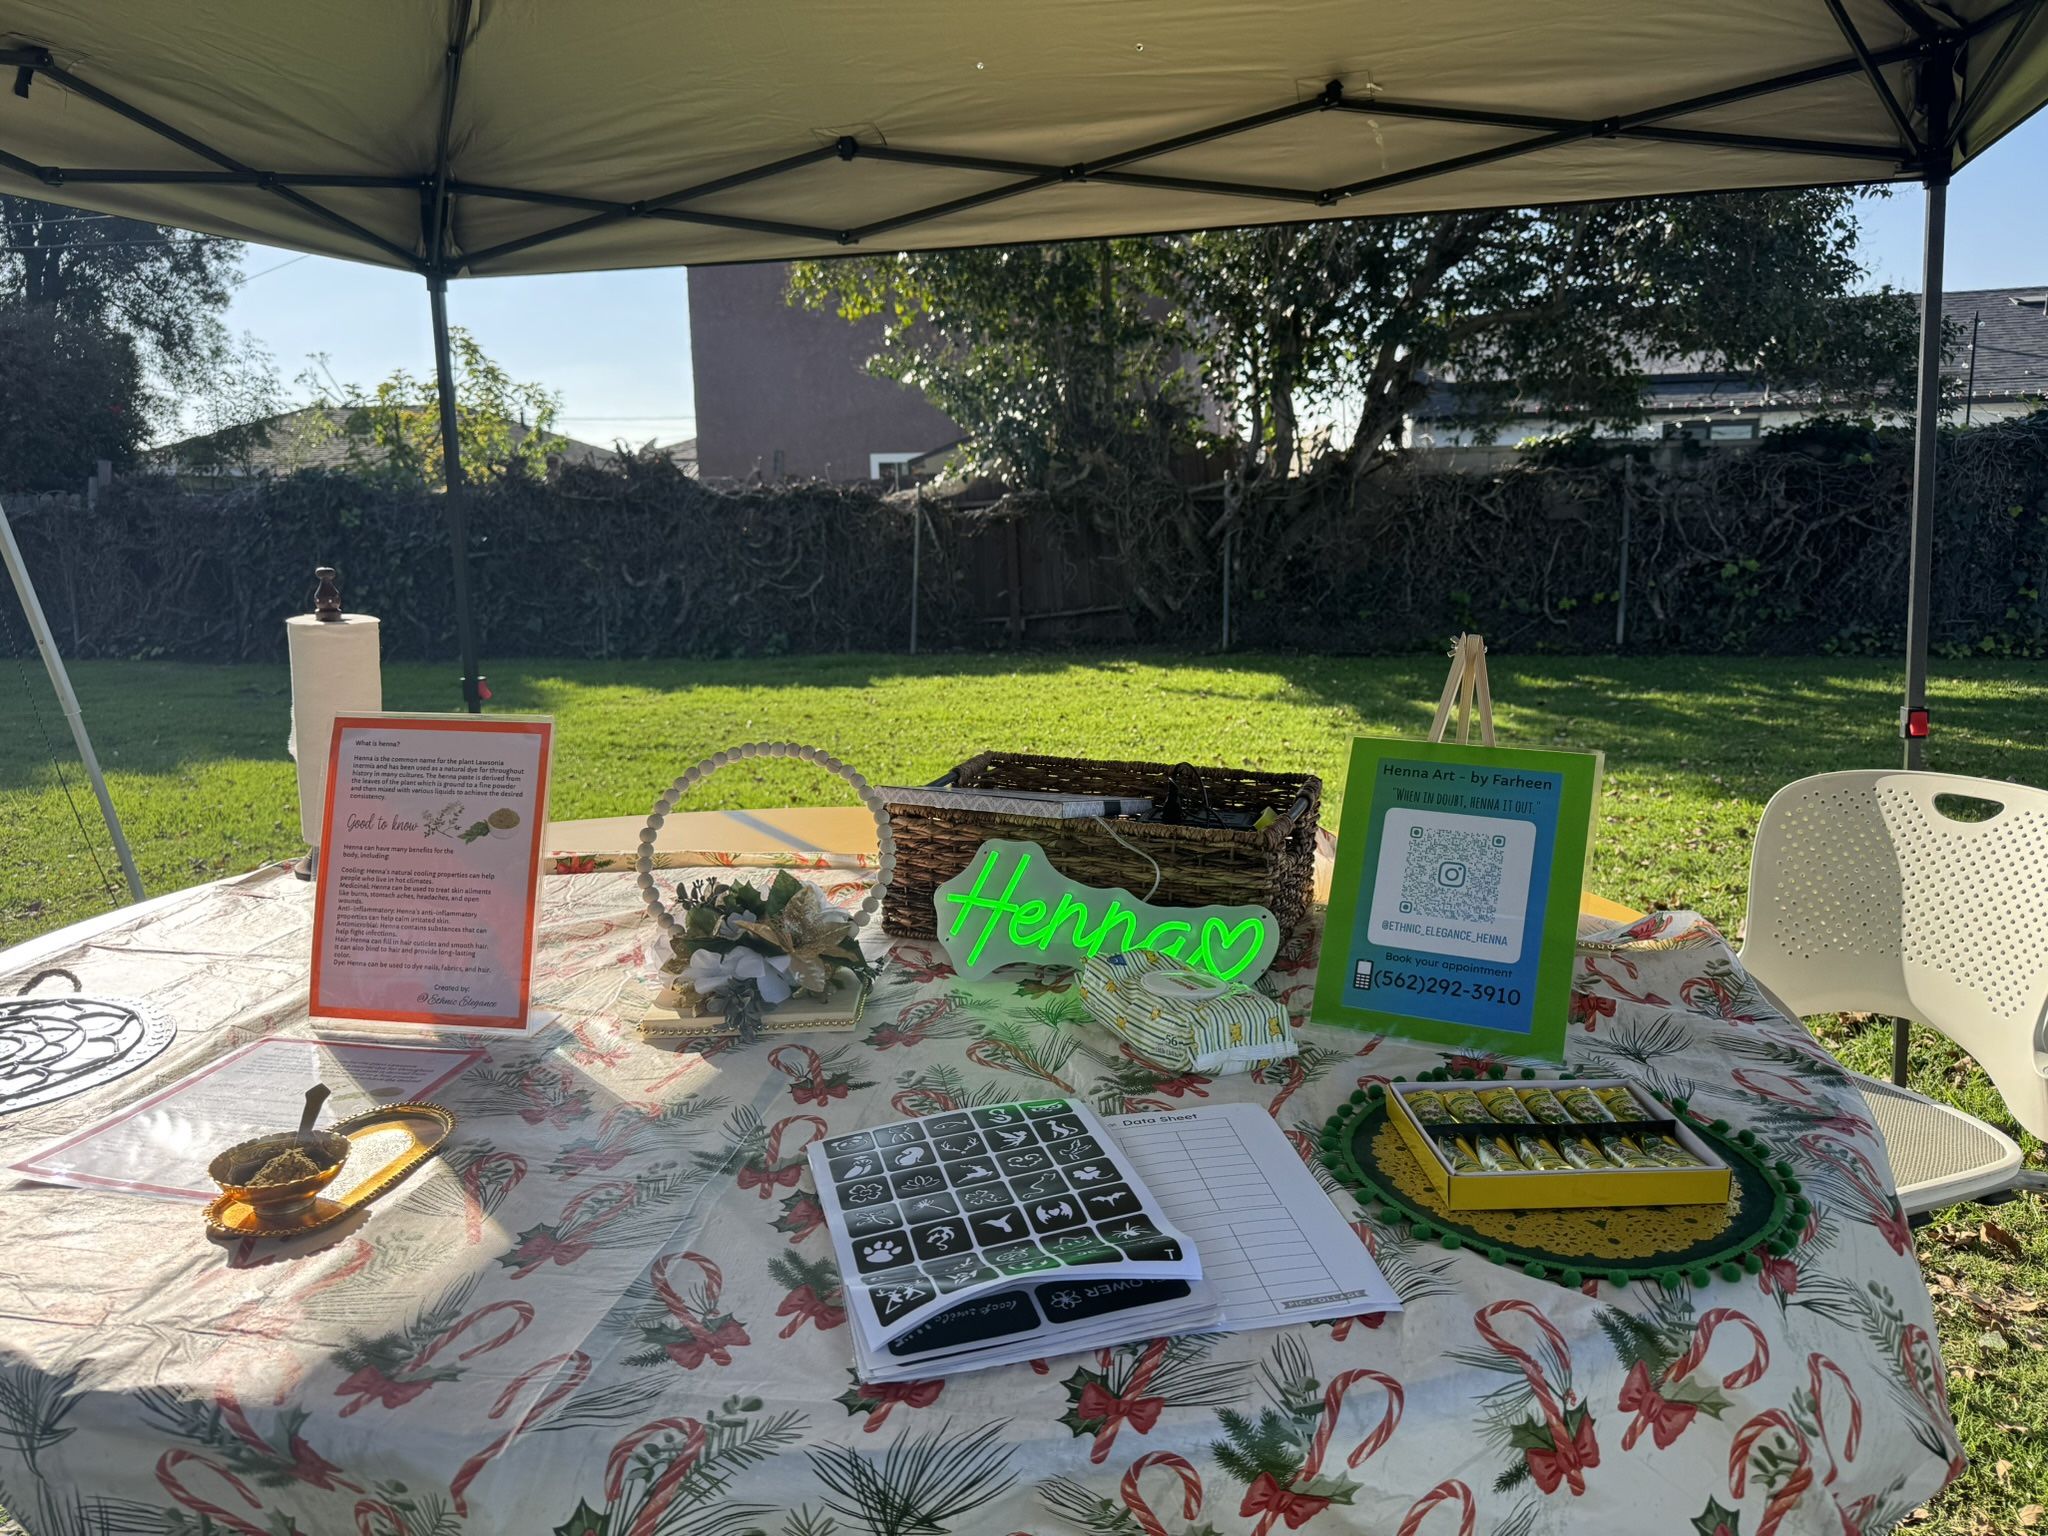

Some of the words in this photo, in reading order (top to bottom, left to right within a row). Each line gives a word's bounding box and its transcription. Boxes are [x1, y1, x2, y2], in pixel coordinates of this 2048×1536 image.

[1383, 764, 1428, 779] Henna
[1432, 768, 1455, 782] Art
[1470, 771, 1488, 788] by
[1493, 774, 1552, 790] Farheen
[1424, 792, 1433, 804] IN
[1470, 796, 1500, 811] HENNA
[1503, 800, 1512, 812] IT
[346, 812, 375, 832] Good
[377, 816, 388, 830] to
[392, 814, 418, 832] know
[421, 909, 477, 918] anti-inflammatory
[946, 851, 1201, 967] Henna
[1382, 920, 1508, 946] @ETHNIC_ELEGANCE_HENNA
[438, 949, 475, 957] long-lasting
[1386, 952, 1412, 964] Book
[1415, 957, 1439, 968] your
[1442, 962, 1512, 978] appointment
[1374, 970, 1521, 1006] (562)292-3910
[1166, 1033, 1178, 1046] 56
[1160, 1114, 1198, 1122] Sheet
